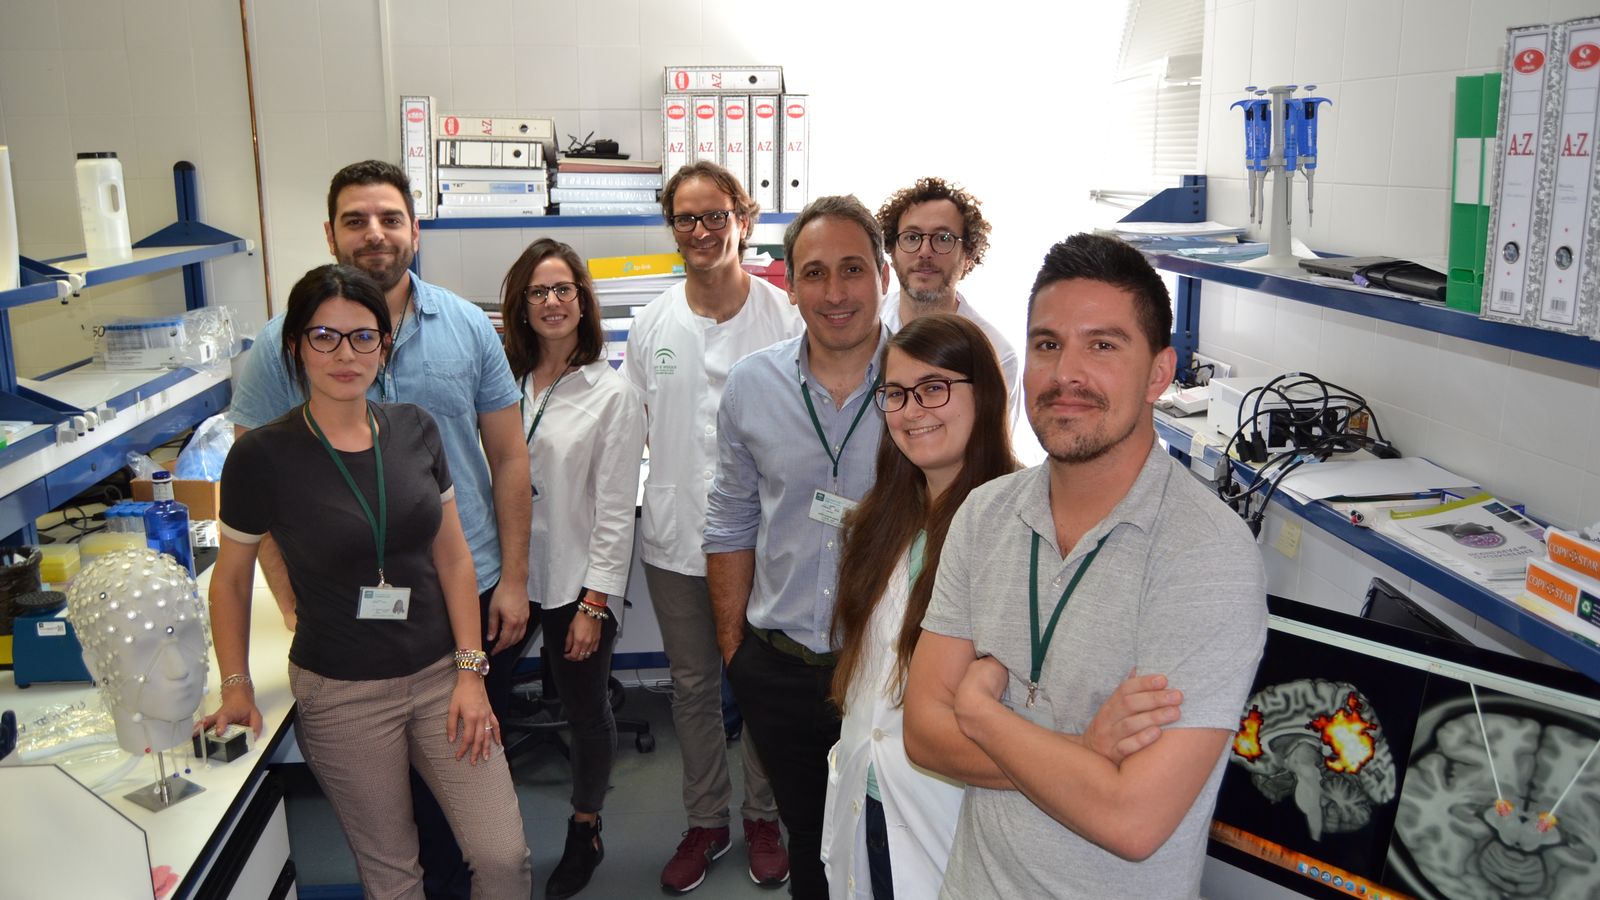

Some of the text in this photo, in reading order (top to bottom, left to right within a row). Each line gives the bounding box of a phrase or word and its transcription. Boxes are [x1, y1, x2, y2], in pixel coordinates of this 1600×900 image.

[712, 73, 721, 88] A-Z
[482, 120, 492, 135] A-Z
[669, 142, 684, 153] A-Z
[699, 142, 713, 153] A-Z
[728, 143, 742, 153] A-Z
[758, 141, 772, 151] A-Z
[1508, 132, 1534, 156] A-Z
[1561, 132, 1589, 156] A-Z
[408, 146, 424, 157] A-Z
